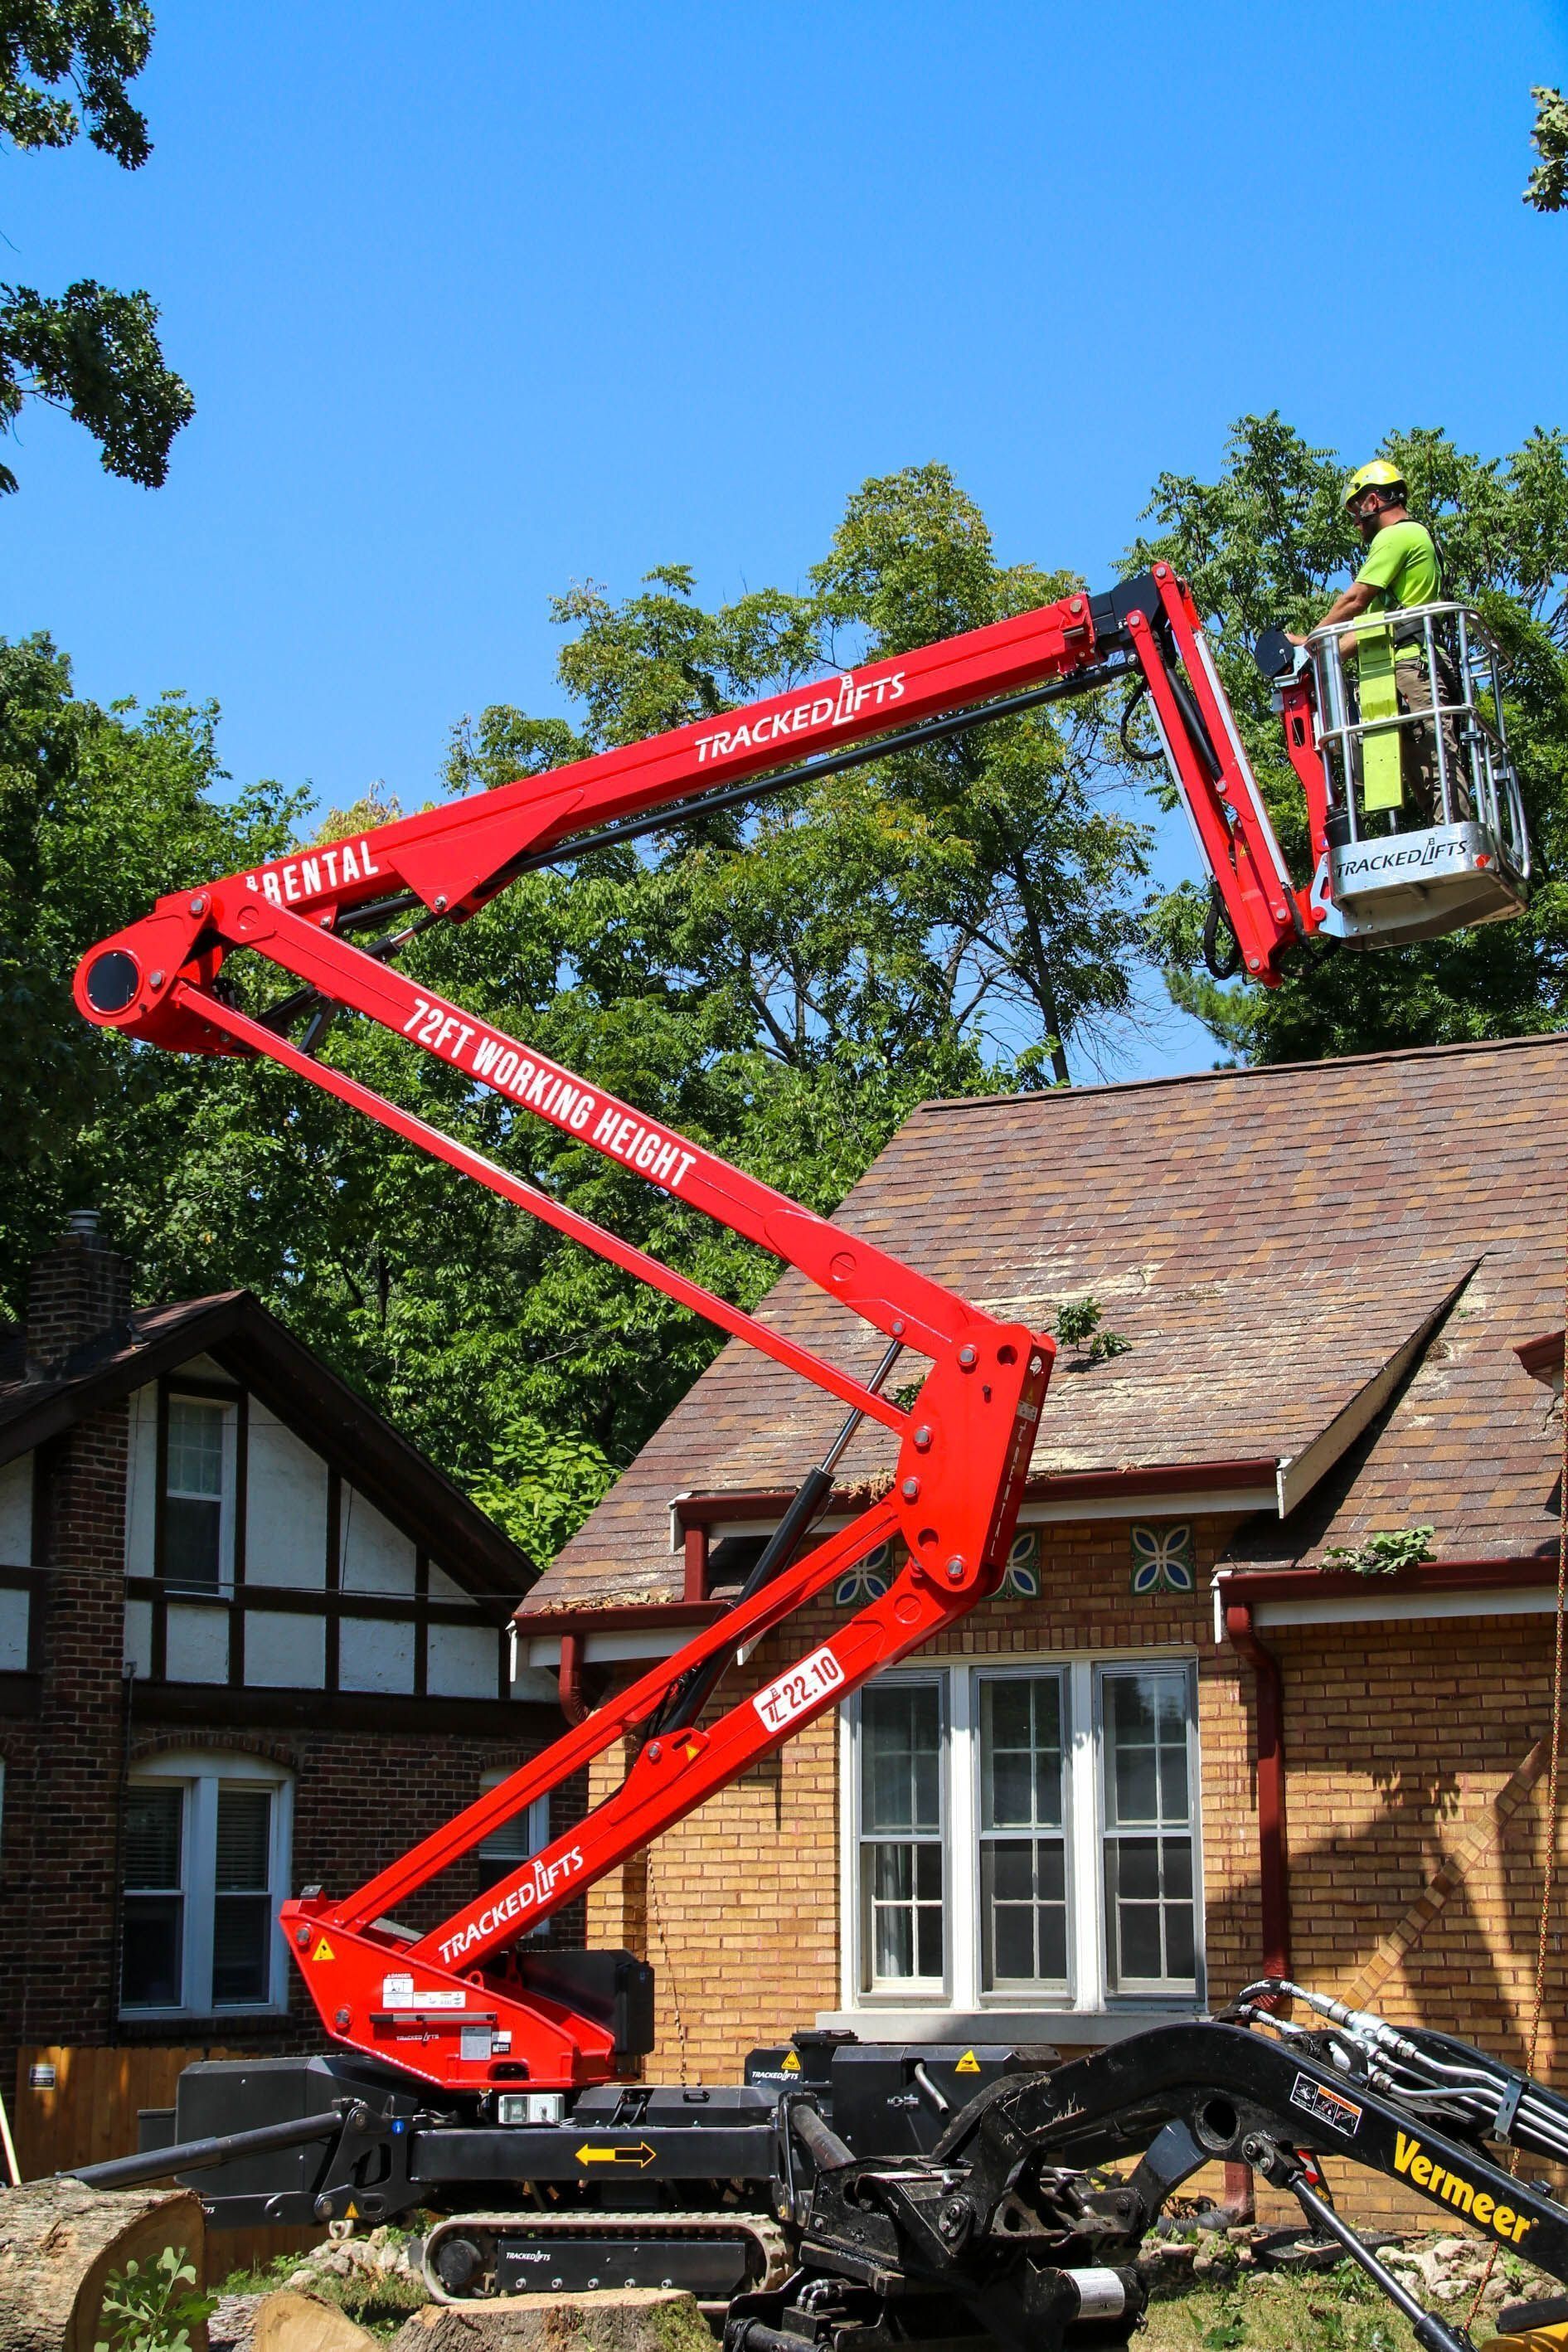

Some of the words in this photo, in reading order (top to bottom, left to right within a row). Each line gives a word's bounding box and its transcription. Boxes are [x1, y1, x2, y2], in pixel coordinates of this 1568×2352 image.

[262, 840, 379, 905] RENTAL
[403, 998, 475, 1059] 72FT
[472, 1037, 595, 1130] WORKING
[592, 1107, 697, 1187] HEIGHT
[1394, 2131, 1532, 2243] Vermeer
